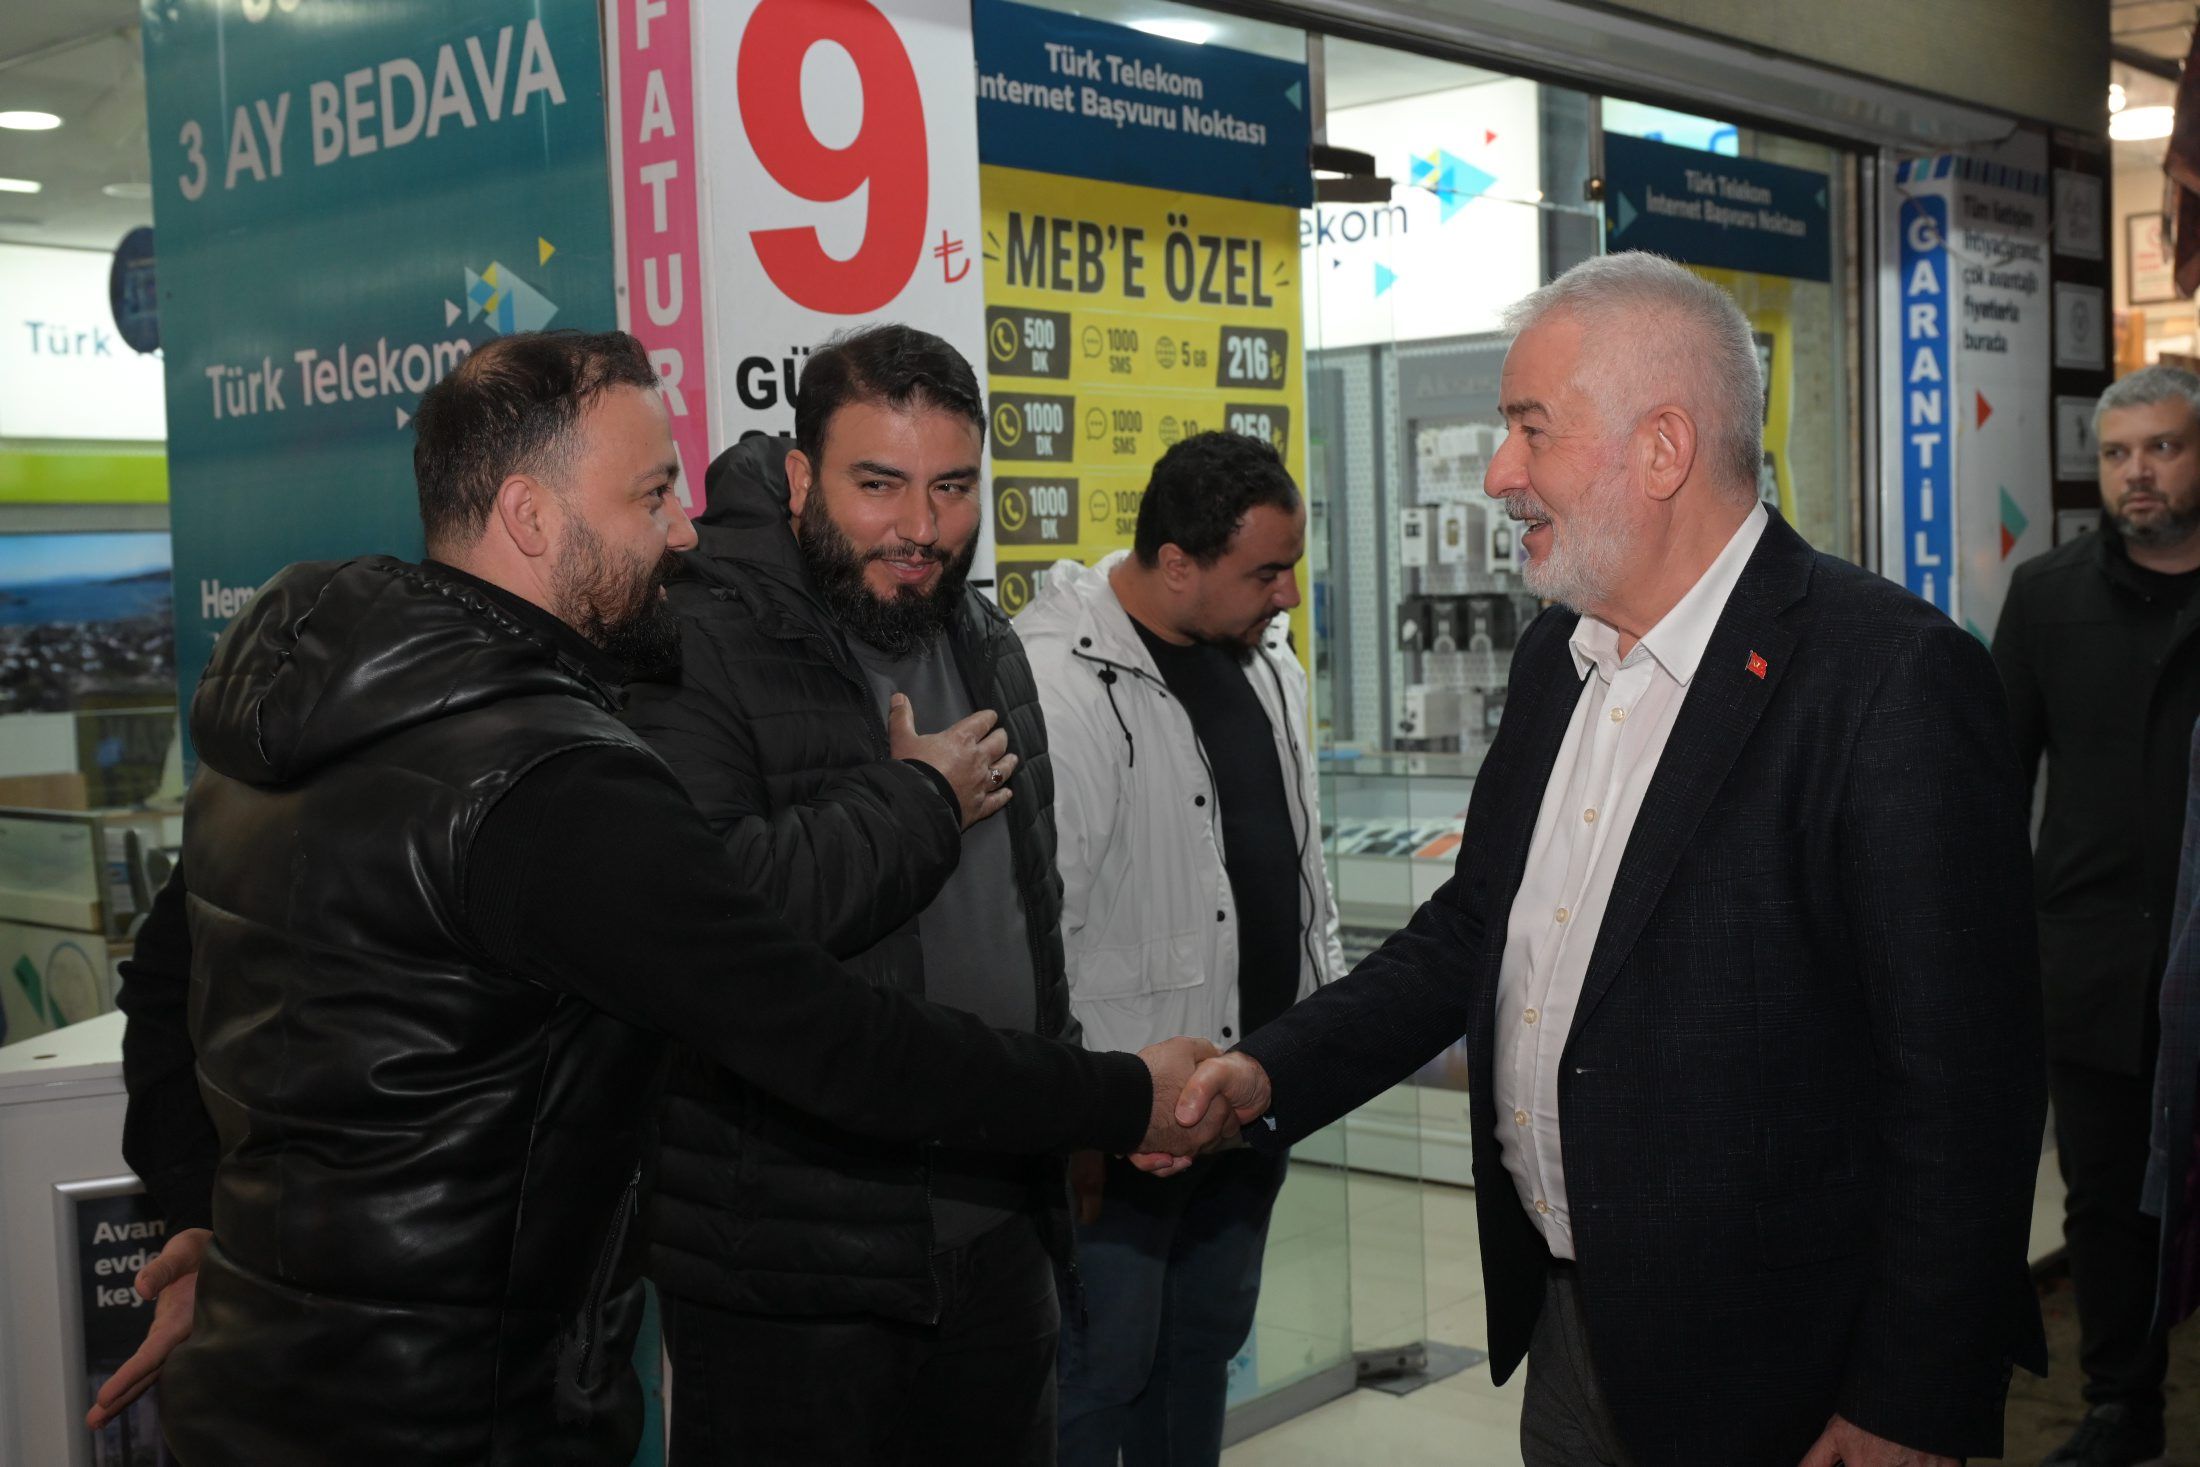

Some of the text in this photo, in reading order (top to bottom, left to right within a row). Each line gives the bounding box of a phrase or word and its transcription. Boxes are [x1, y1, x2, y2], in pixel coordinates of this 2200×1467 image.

[1044, 42, 1203, 100] Türk Telekom
[179, 18, 567, 201] 3 AY BEDAVA
[1081, 86, 1177, 129] Başvuru
[1183, 104, 1267, 146] Noktası
[737, 0, 928, 316] 9
[1006, 211, 1274, 308] MEB'E ÖZEL
[24, 320, 112, 356] Türk
[1024, 318, 1056, 349] 500
[1107, 328, 1139, 353] 1000
[1032, 351, 1050, 373] DK
[1109, 355, 1132, 375] SMS
[1181, 342, 1191, 367] 5
[205, 336, 473, 419] Türk Telekom
[1024, 402, 1064, 434] 1000
[1112, 409, 1143, 433] 1000
[1908, 216, 1941, 603] GARANTİLİ
[1036, 434, 1054, 456] DK
[1113, 436, 1137, 455] SMS
[1029, 486, 1069, 517] 1000
[1114, 490, 1145, 514] 100
[1040, 518, 1058, 540] DK
